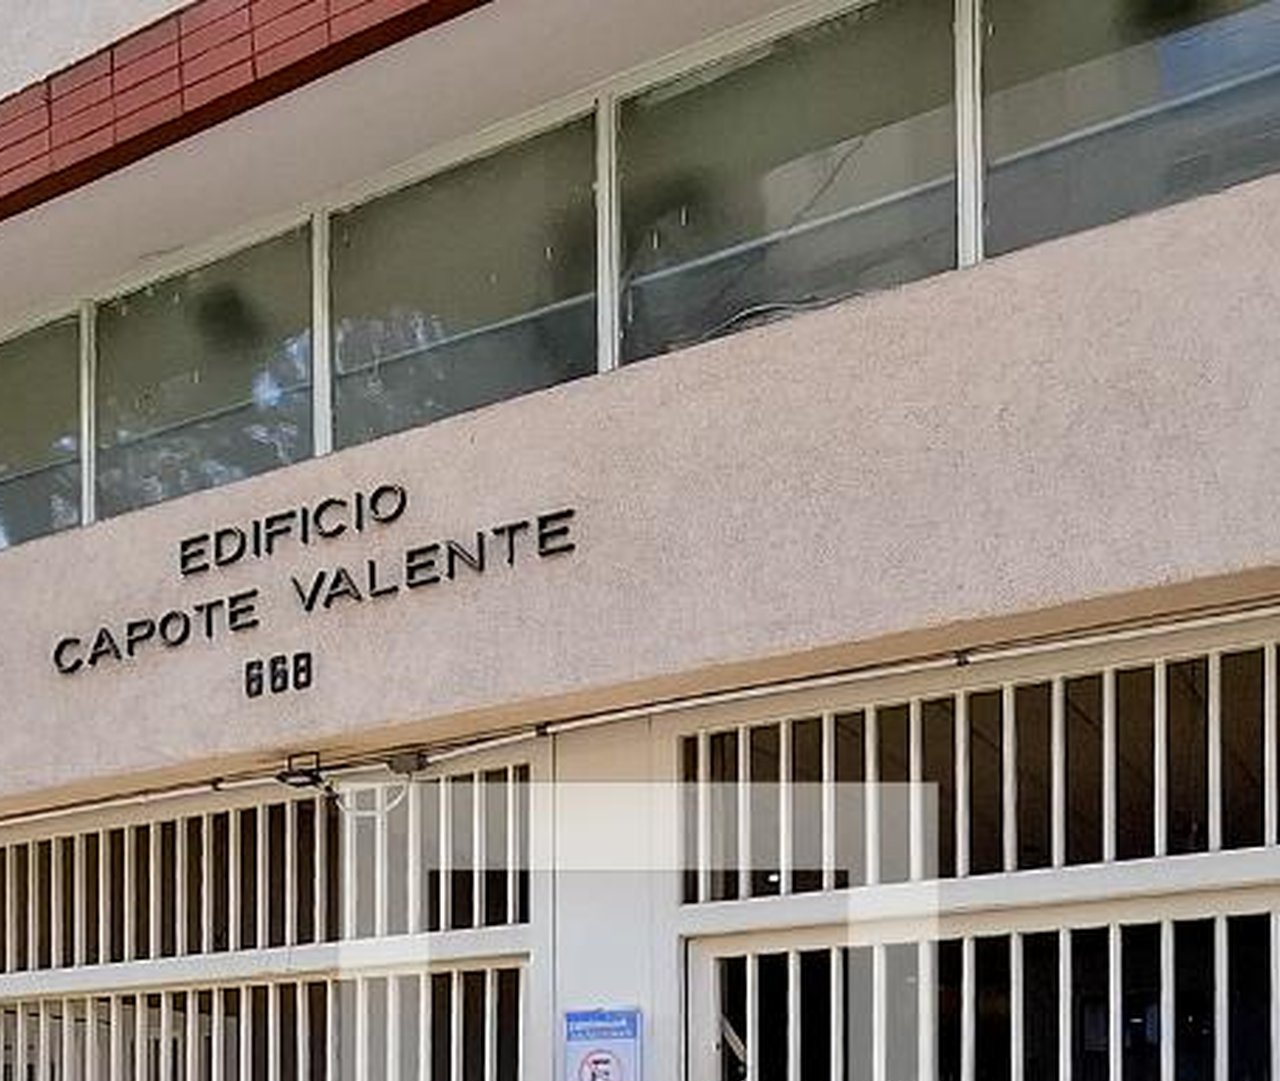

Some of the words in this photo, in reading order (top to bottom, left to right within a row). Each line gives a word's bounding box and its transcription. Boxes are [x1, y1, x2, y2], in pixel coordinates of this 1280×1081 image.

[179, 484, 408, 577] EDIFICIO
[52, 590, 261, 676] CAPOTE
[293, 509, 576, 612] VALENTE
[244, 651, 313, 698] 668
